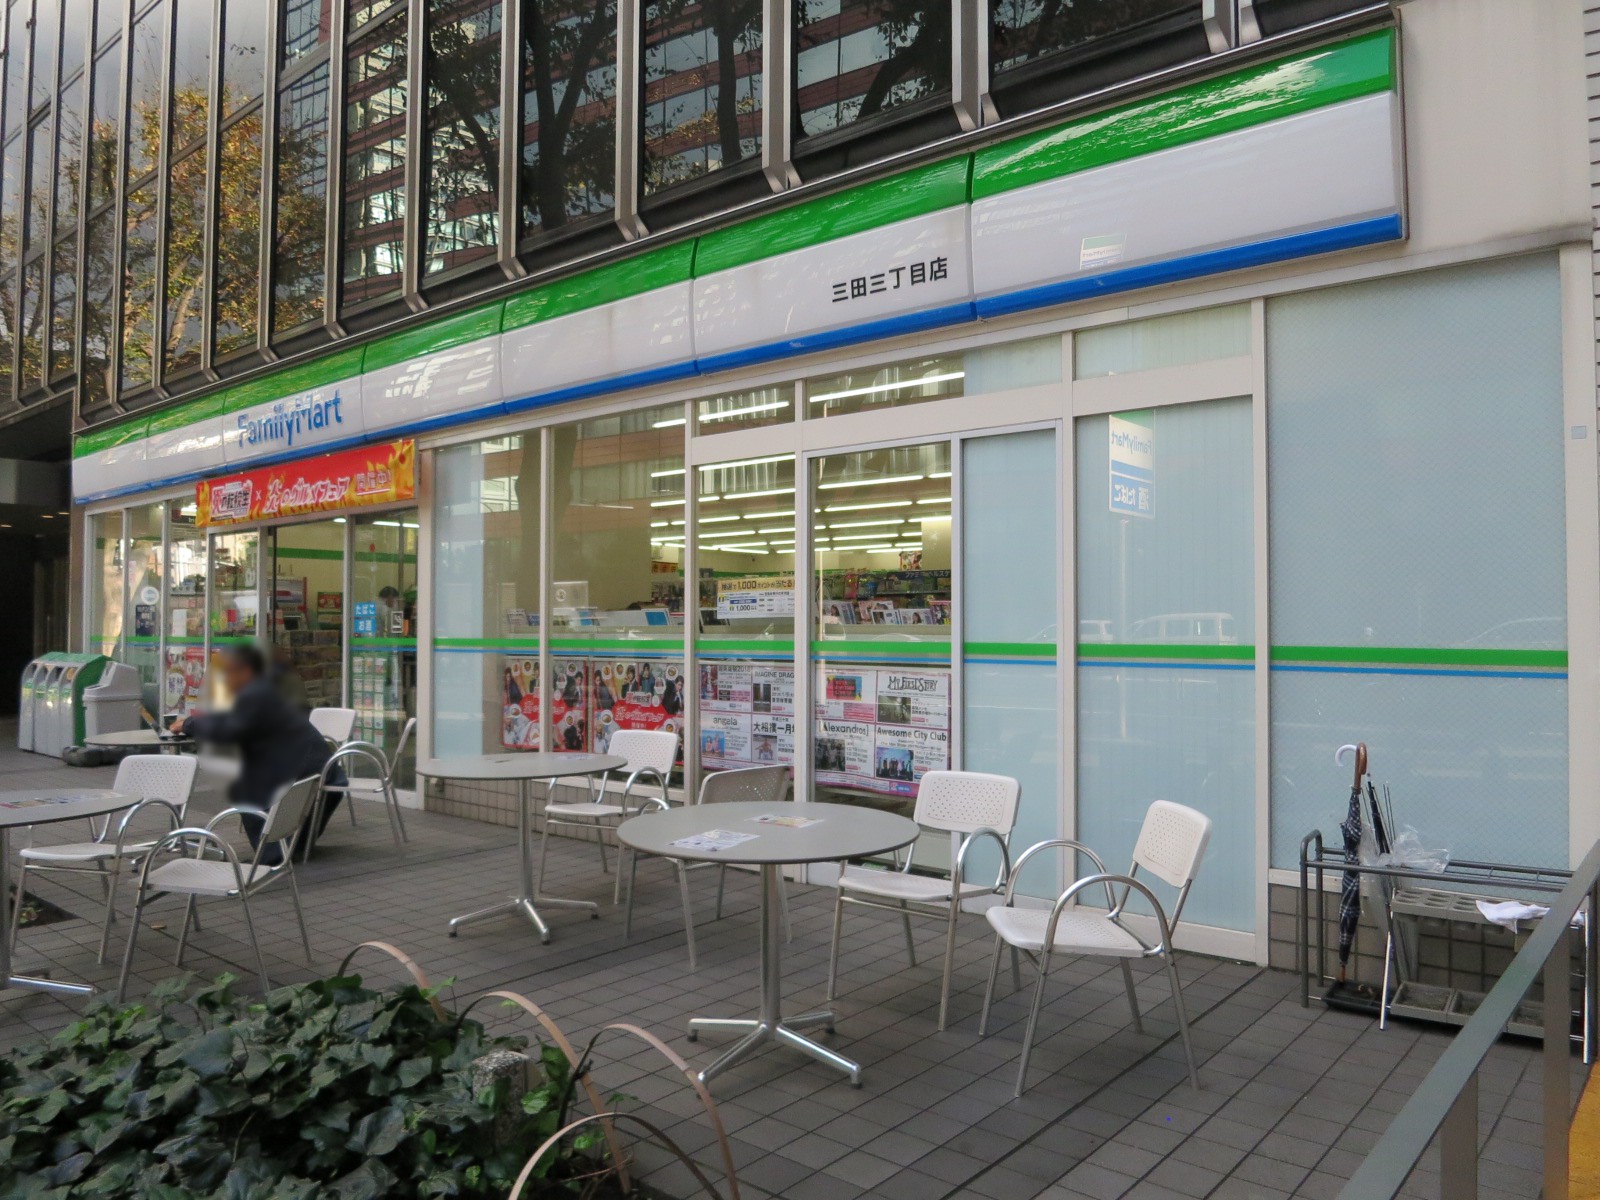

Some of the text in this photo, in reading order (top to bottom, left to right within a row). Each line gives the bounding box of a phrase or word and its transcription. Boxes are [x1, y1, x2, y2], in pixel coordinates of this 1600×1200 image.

[831, 256, 949, 303] 三田三丁目店
[237, 388, 343, 447] FamilyMart
[355, 604, 375, 615] たばこ
[712, 716, 738, 726] angela
[877, 727, 947, 742] Awesome City Club
